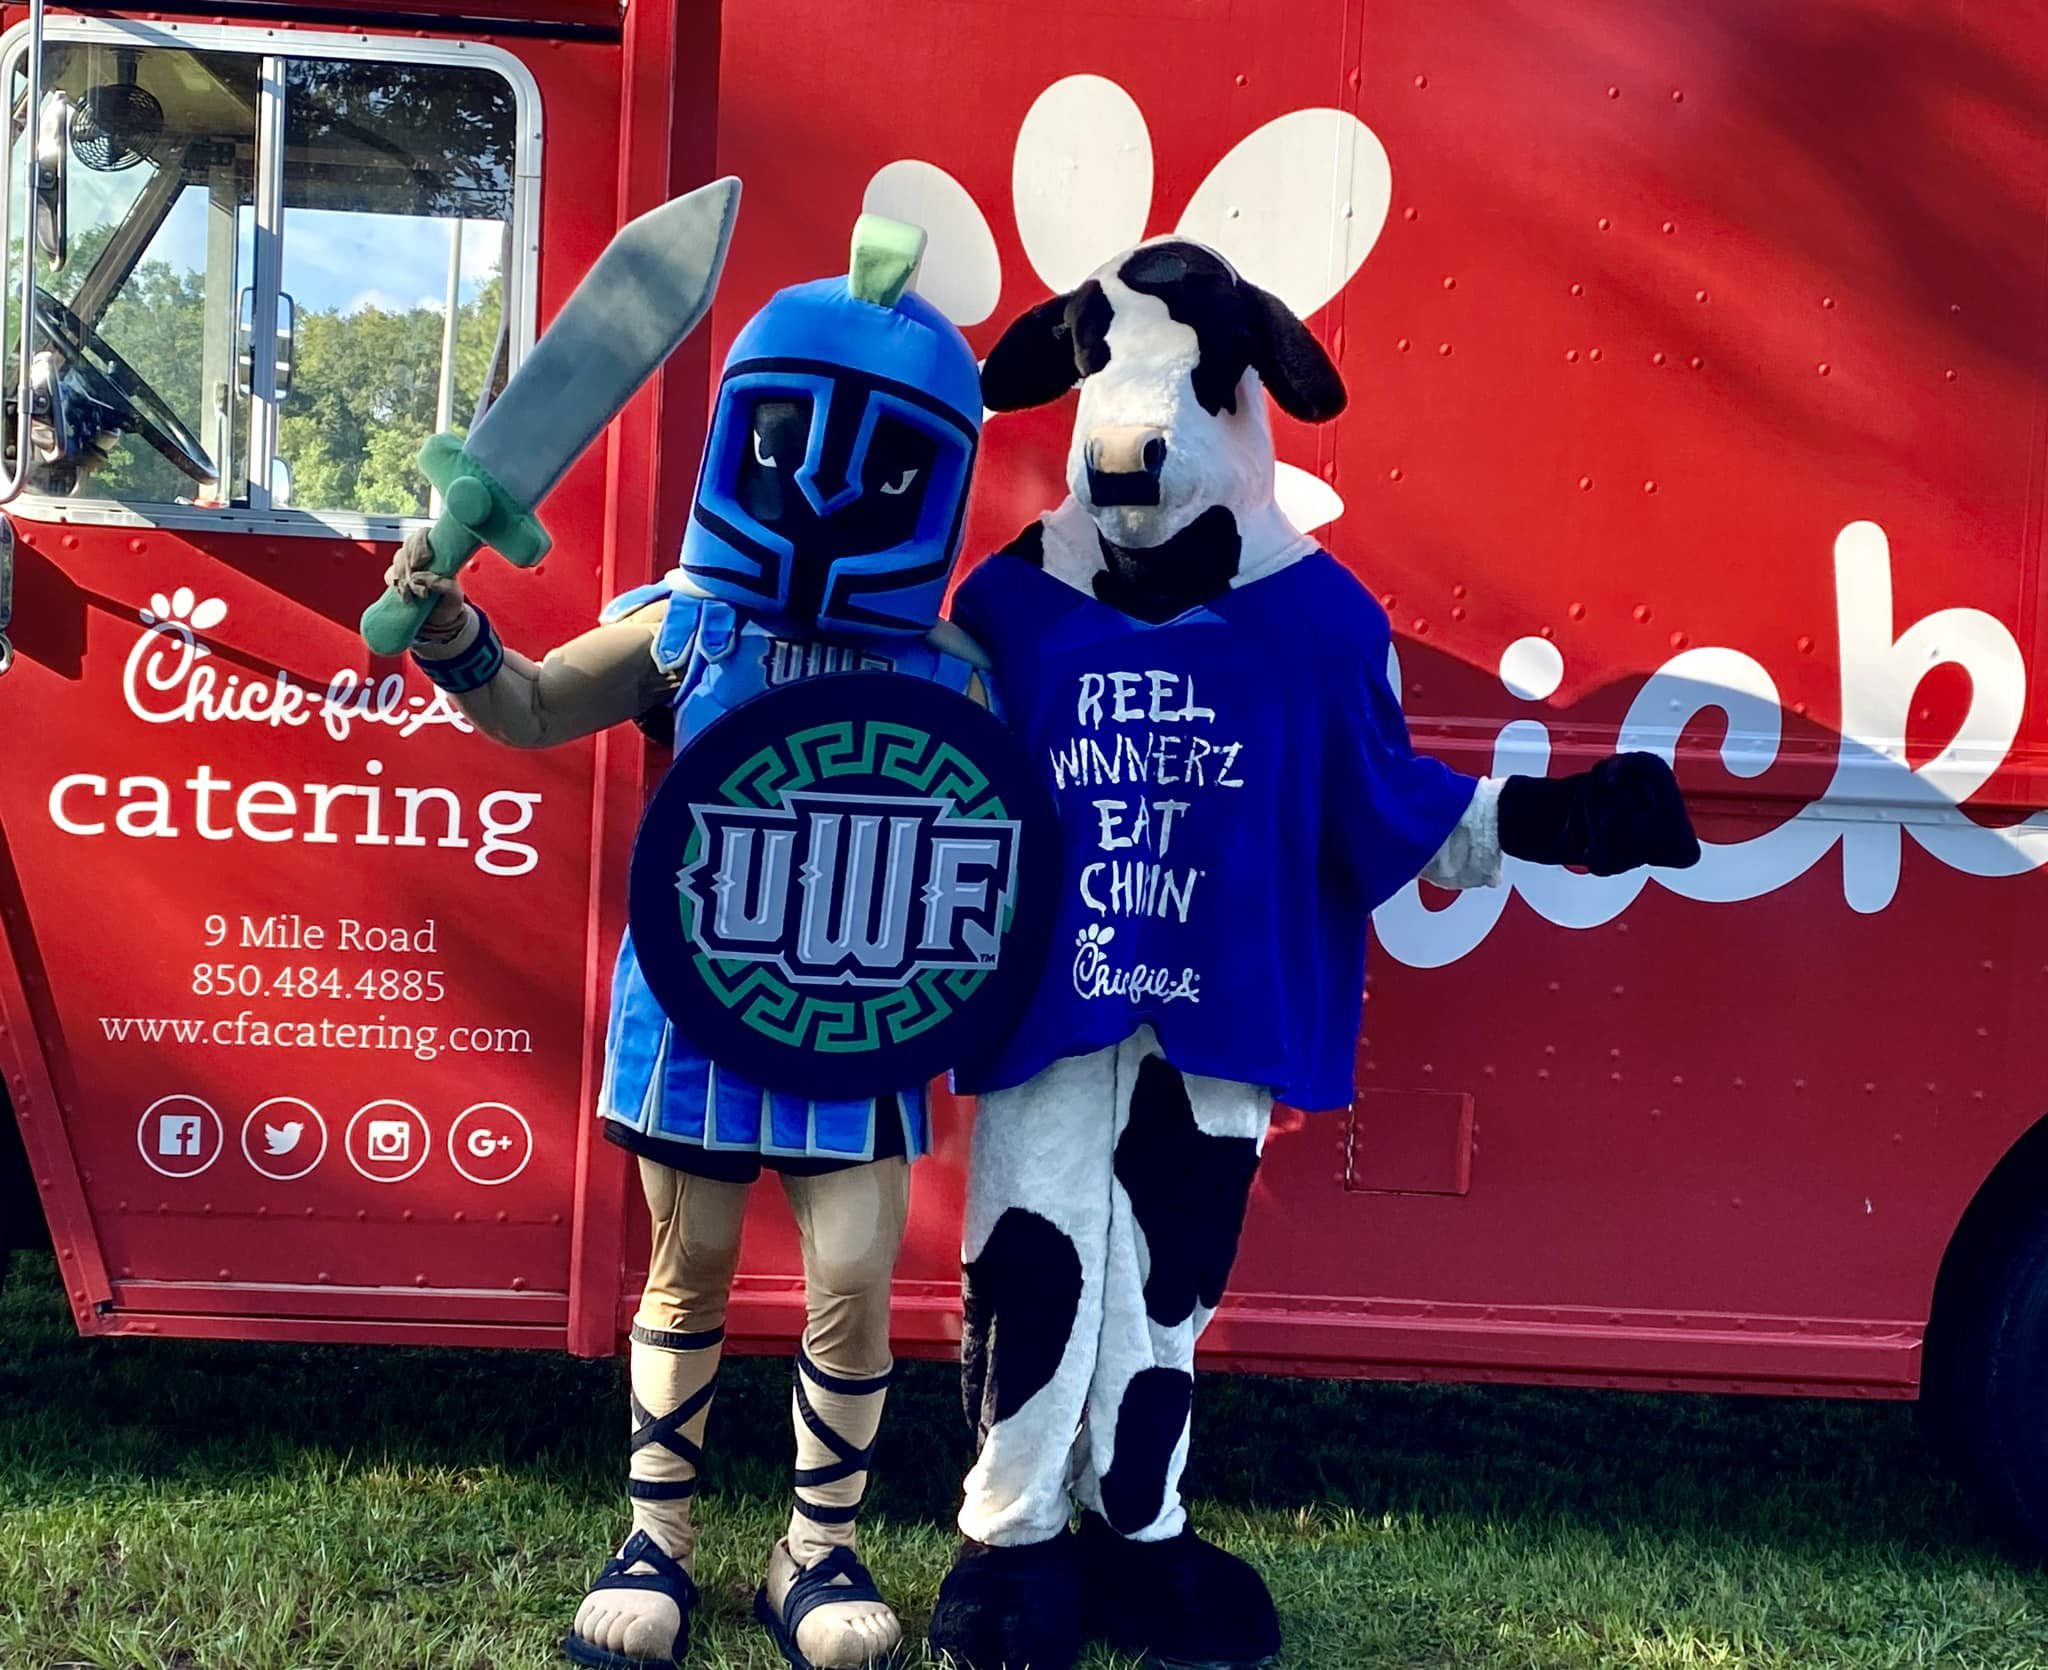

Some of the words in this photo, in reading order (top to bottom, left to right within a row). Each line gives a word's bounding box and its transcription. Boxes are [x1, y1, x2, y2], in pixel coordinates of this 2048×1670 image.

[123, 618, 474, 742] Chick-fil-A
[1077, 669, 1216, 731] REEL
[1049, 731, 1245, 790] WINNERZ
[1372, 520, 2048, 968] ick
[48, 759, 542, 877] catering
[1092, 794, 1192, 859] EAT
[710, 811, 1001, 970] UWF
[203, 914, 228, 948] 9
[239, 915, 325, 951] Mile
[337, 919, 438, 955] Road
[191, 964, 445, 1002] 850.484.4885
[98, 1010, 533, 1061] www.cfacatering.com
